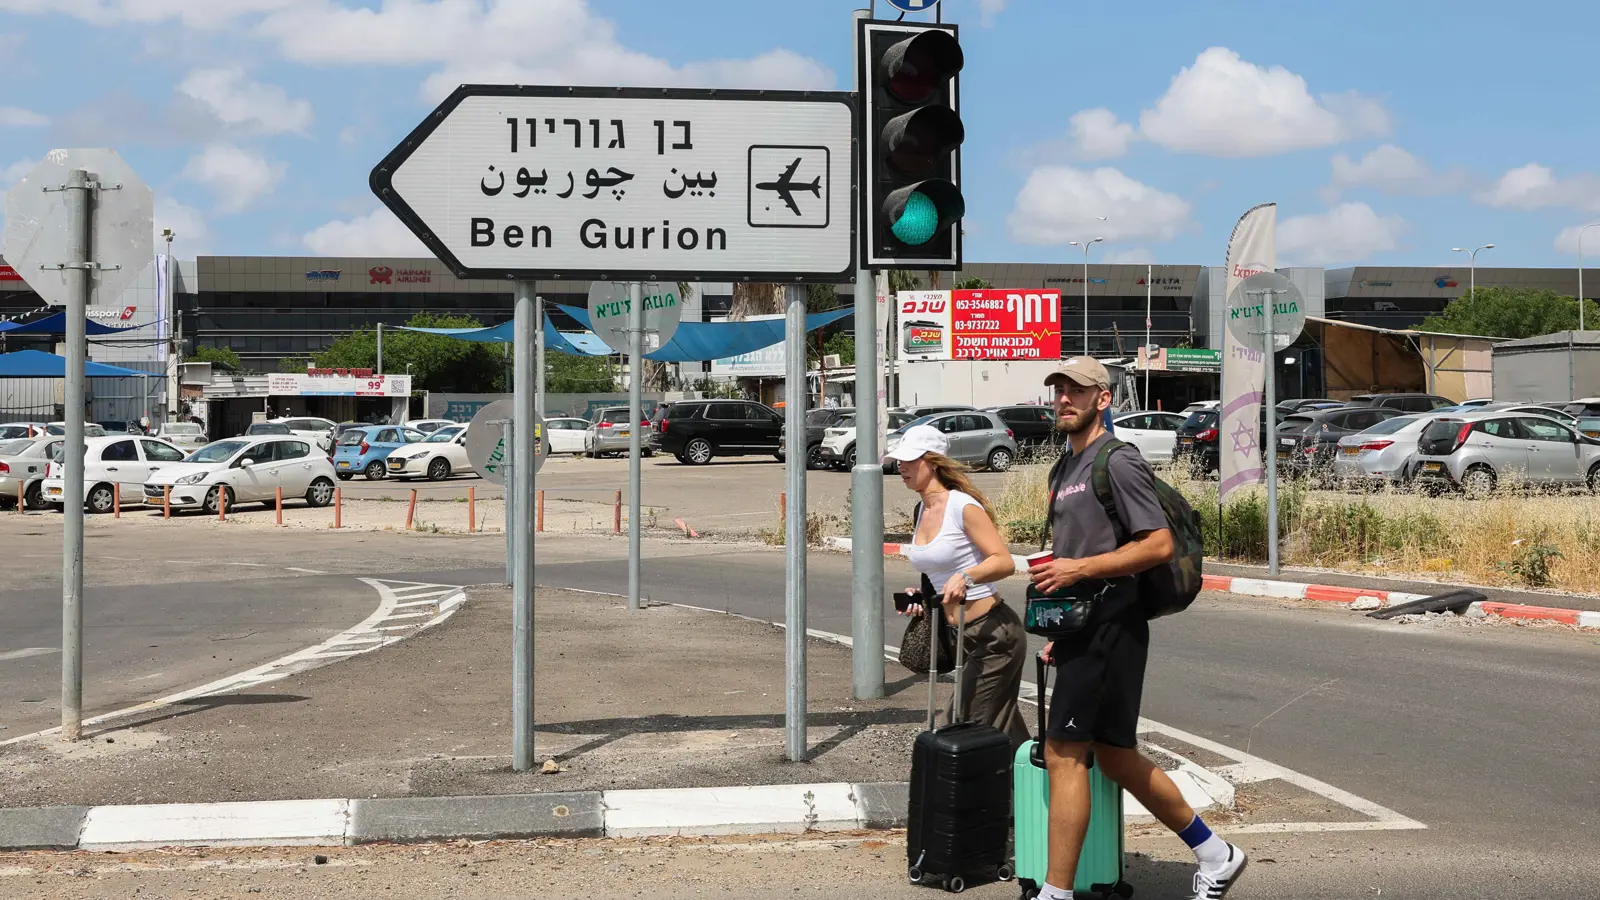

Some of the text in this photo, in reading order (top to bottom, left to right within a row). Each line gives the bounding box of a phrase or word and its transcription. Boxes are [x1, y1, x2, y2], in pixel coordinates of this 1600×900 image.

[506, 117, 693, 155] בן גוריון
[470, 217, 727, 250] Ben Gurion
[956, 299, 1005, 310] 052-3546882
[1006, 293, 1058, 330] דחף
[955, 320, 1000, 331] 03-9737222
[956, 335, 1032, 347] מכונאות חשמל
[956, 346, 982, 358] לרכב
[983, 347, 1007, 357] אוויר
